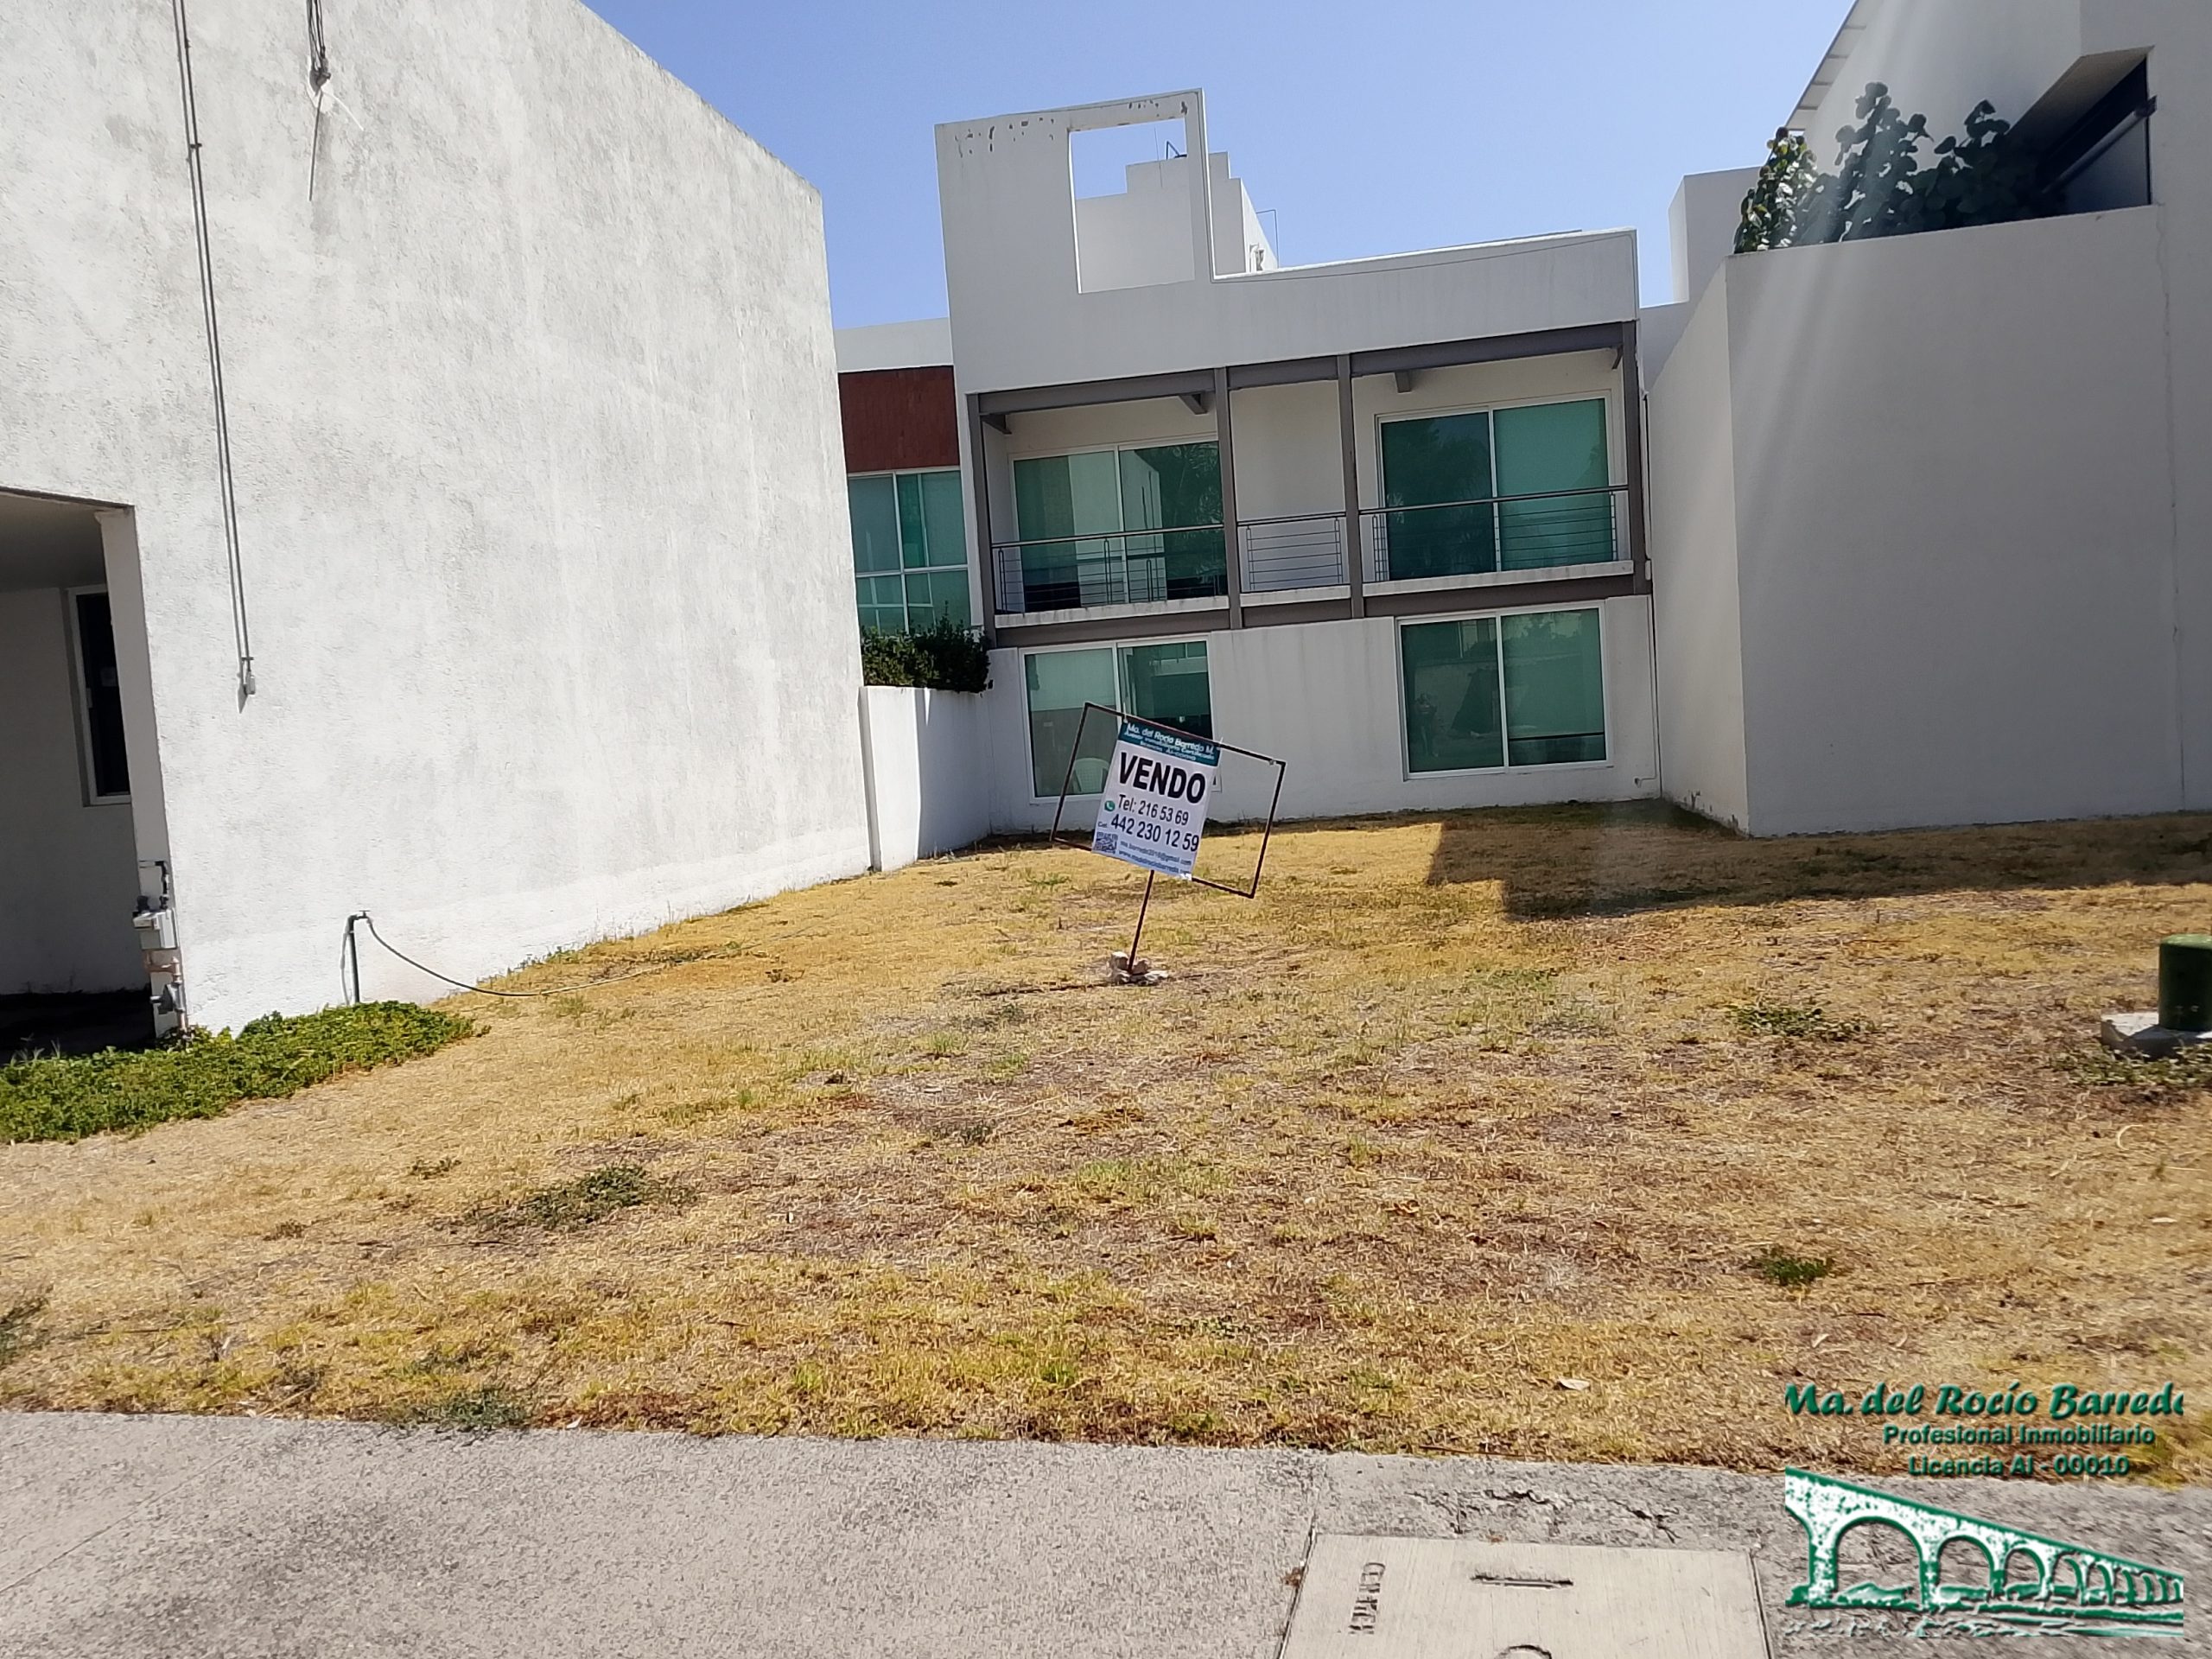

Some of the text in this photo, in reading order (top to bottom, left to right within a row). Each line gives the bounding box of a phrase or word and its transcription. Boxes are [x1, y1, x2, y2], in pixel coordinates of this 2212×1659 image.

[1119, 752, 1206, 804] VENDO
[1118, 794, 1189, 825] Tel: 216 53 69
[1111, 814, 1135, 835] 442
[1136, 821, 1161, 842] 230
[1166, 829, 1180, 848] 12
[1182, 833, 1200, 852] 59
